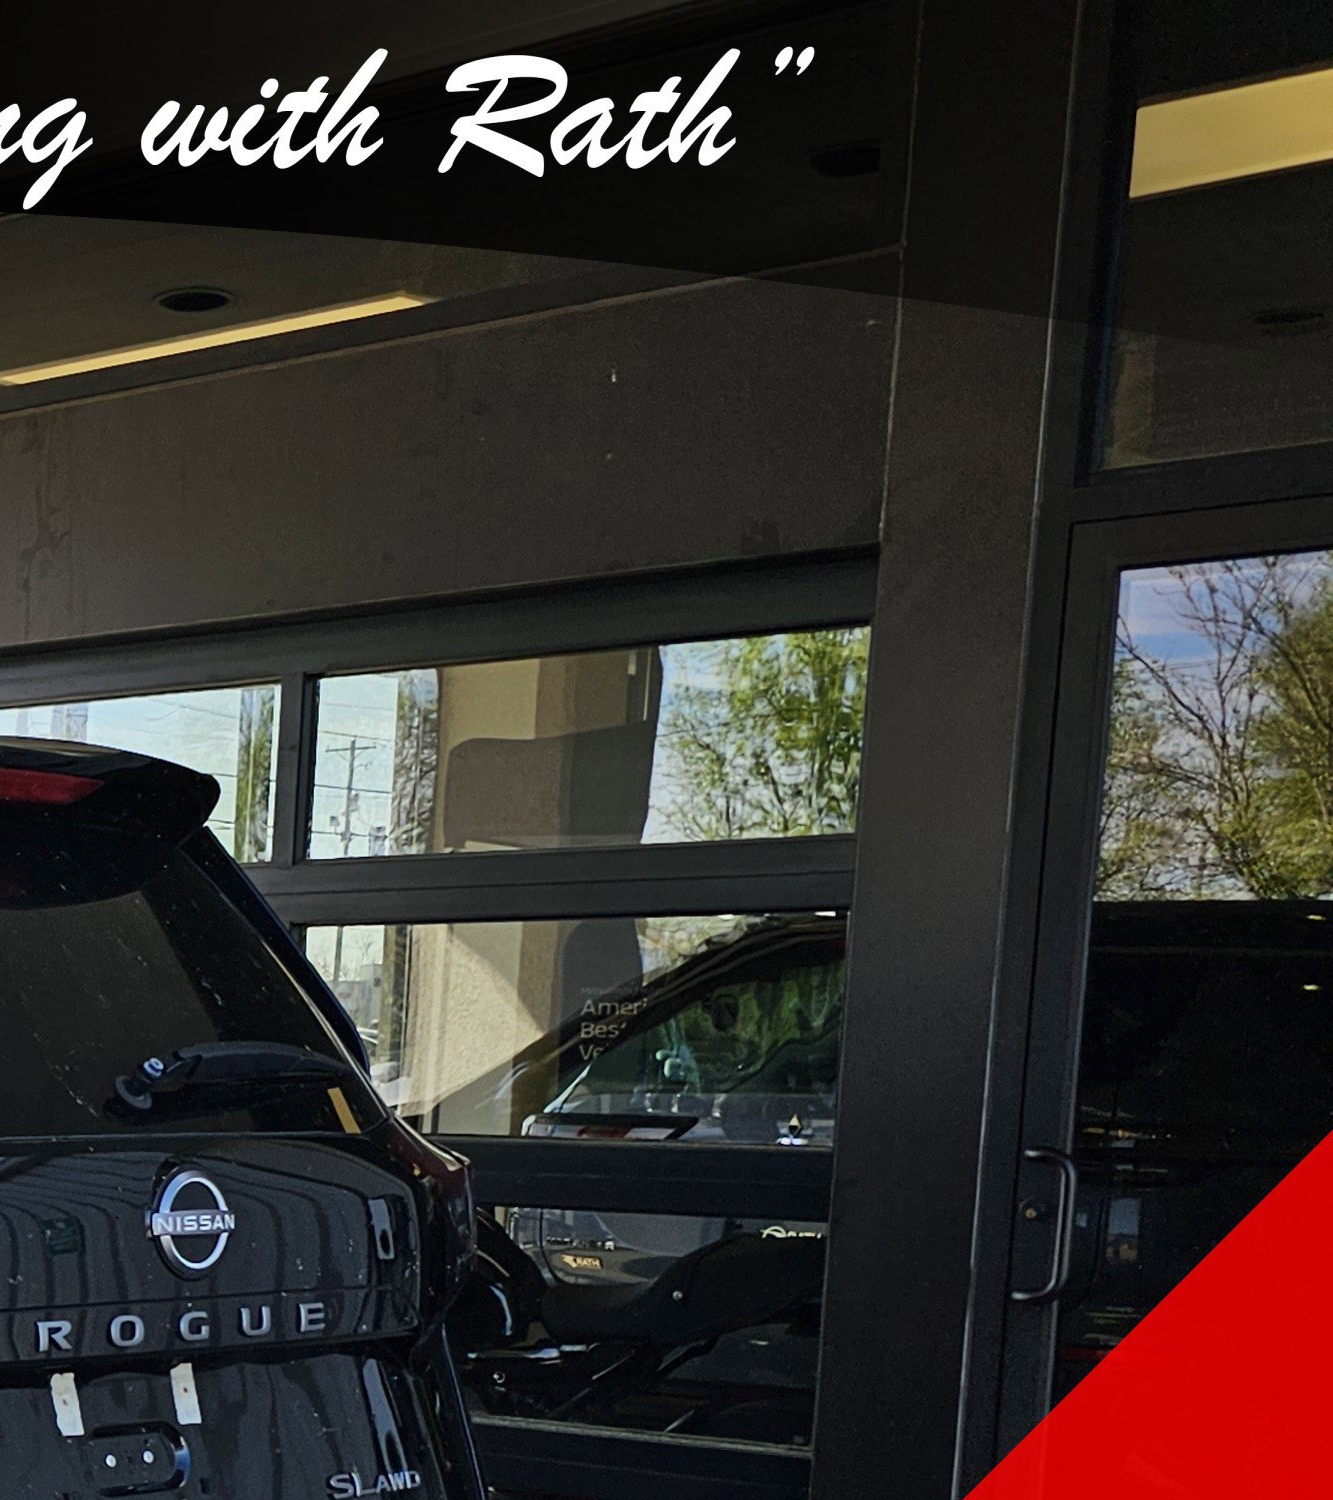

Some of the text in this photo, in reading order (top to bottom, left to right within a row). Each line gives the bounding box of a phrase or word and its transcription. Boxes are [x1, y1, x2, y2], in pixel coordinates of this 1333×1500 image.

[580, 1021, 626, 1039] Bes
[154, 1212, 235, 1235] NISSAN
[36, 1302, 327, 1352] ROGUE
[375, 1470, 421, 1493] AWD
